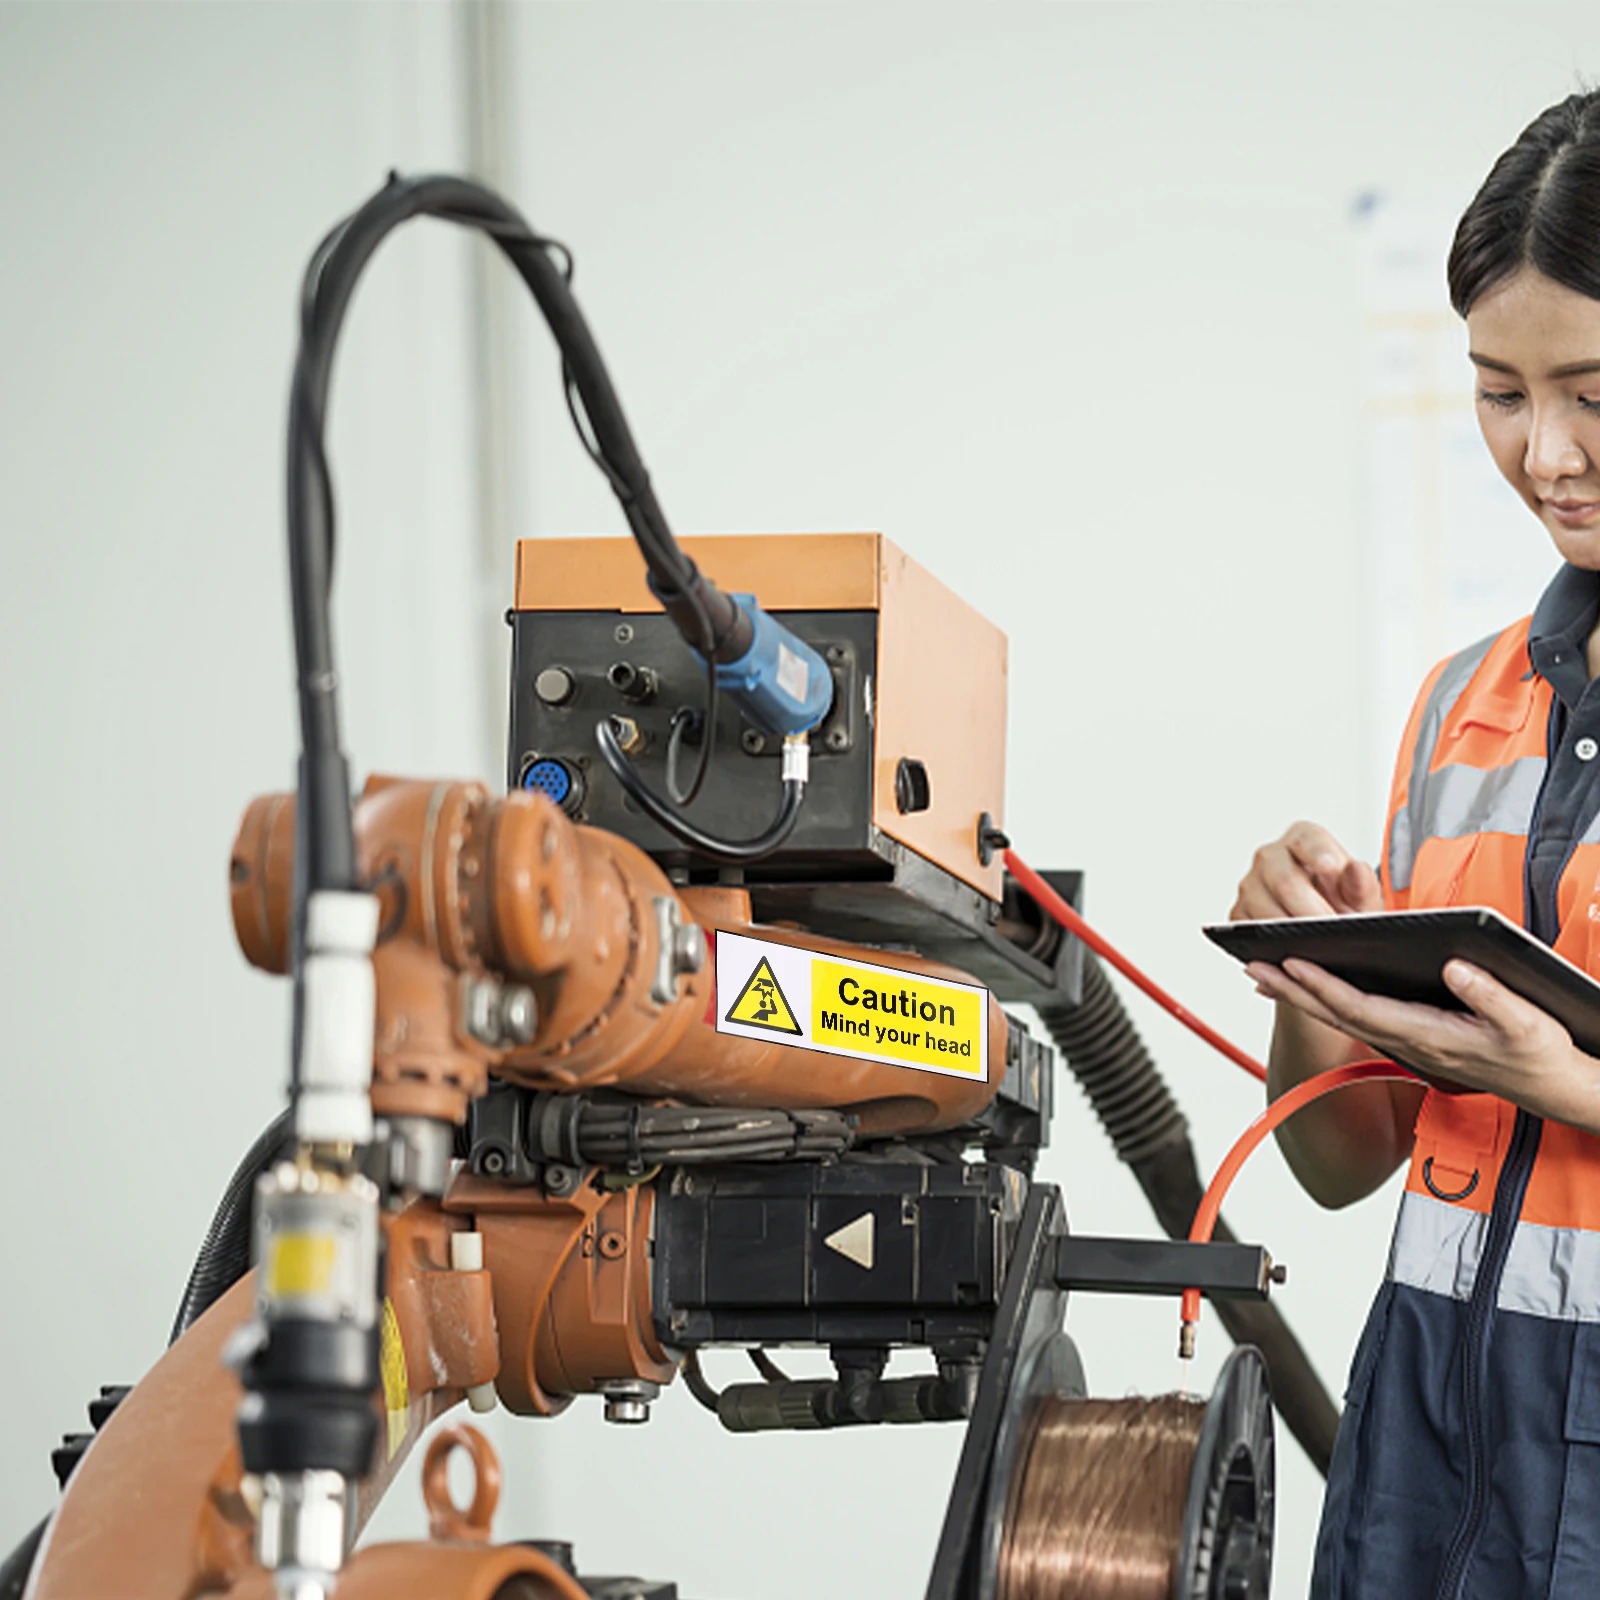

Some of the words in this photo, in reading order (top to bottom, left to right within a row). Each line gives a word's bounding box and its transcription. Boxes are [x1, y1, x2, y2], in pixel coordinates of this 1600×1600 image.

[838, 977, 955, 1026] Caution
[821, 1011, 870, 1037] Mind
[875, 1025, 921, 1047] your
[925, 1031, 971, 1057] head
